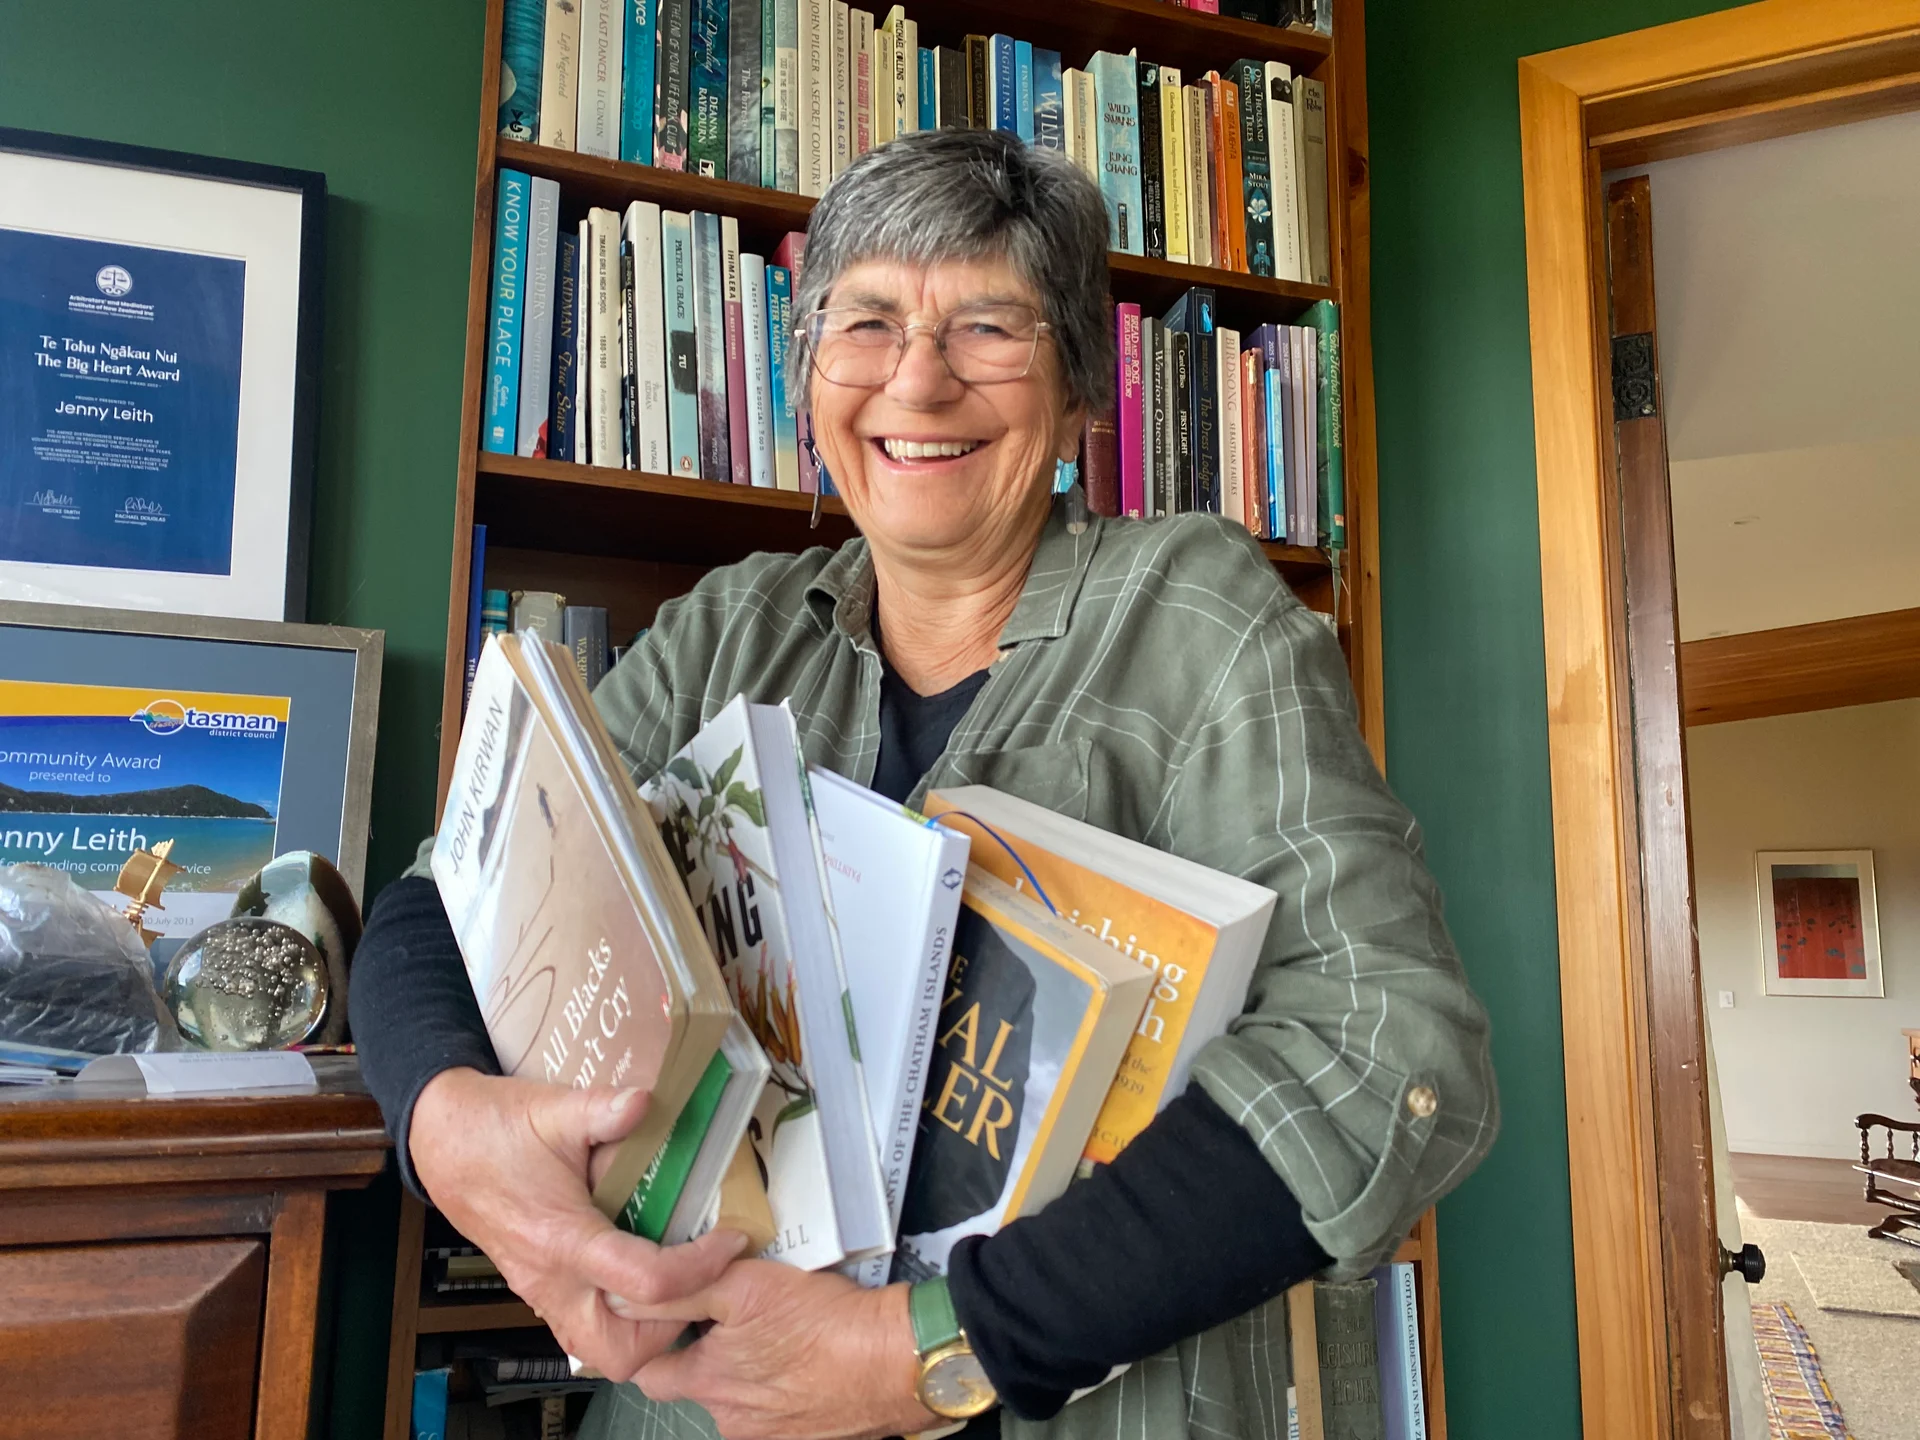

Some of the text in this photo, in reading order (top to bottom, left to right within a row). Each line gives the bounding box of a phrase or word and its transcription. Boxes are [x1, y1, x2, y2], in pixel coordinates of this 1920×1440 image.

[809, 0, 821, 31] JOHN
[836, 10, 845, 41] MARY
[556, 32, 571, 99] Left Neglected
[597, 13, 609, 82] LAST DANCER
[694, 20, 721, 73] Darjeeling
[811, 33, 821, 71] PILGER
[895, 20, 904, 80] MICHAEL COLLINS
[666, 3, 682, 147] THE END OF YOUR LIFE BOOK CLUB
[741, 68, 751, 87] The
[836, 46, 845, 91] BENSON
[1001, 42, 1012, 120] SIGHTLINES
[1021, 64, 1029, 112] FINDINGS
[697, 87, 708, 143] RAYBOURN
[811, 89, 821, 130] SECRET
[975, 72, 984, 120] GAWANDE
[1107, 103, 1131, 115] WILD
[1226, 89, 1235, 106] RAJ
[1243, 65, 1255, 142] CHESTNUT TREES
[1254, 68, 1265, 142] ONE THOUSAND
[708, 95, 719, 139] DEANNA
[1040, 91, 1059, 149] WILD
[1104, 114, 1136, 127] SWANS
[811, 132, 821, 188] COUNTRY
[837, 135, 846, 157] CRY
[1109, 151, 1132, 163] JUNG
[1105, 163, 1138, 175] CHANG
[1247, 181, 1268, 189] STOUT
[1249, 173, 1267, 181] MIRA
[495, 180, 522, 367] KNOW YOUR PLACE
[532, 195, 552, 321] JACINDA ARDERN
[727, 249, 736, 299] IHIMAERA
[675, 239, 686, 319] PATRICIA GRACE
[68, 301, 94, 310] Institute
[103, 304, 117, 312] New
[118, 306, 143, 316] Zealand
[108, 298, 120, 306] and
[599, 292, 607, 315] SCHOOL
[555, 241, 576, 434] Fiona KIDMAN True Stars
[771, 293, 783, 365] PETER MAHON
[1124, 333, 1132, 356] DAVIES
[1131, 314, 1139, 343] BREAD
[34, 352, 62, 369] The
[67, 356, 89, 375] Big
[93, 359, 133, 377] Heart
[136, 364, 180, 381] Award
[39, 335, 178, 364] Te Tohu Ngākau Nui
[599, 335, 607, 368] 1880-1980
[678, 354, 687, 370] TU
[750, 281, 766, 452] Janet Frame In the Memorial Room
[1131, 360, 1140, 385] ROSES
[1155, 350, 1164, 404] Warrior
[1225, 336, 1237, 411] BIRDSONG
[1329, 329, 1343, 448] The Herbal Yearbook
[55, 401, 153, 423] Jenny Leith
[1154, 408, 1165, 454] Queen
[650, 440, 658, 470] VINTAGE
[711, 437, 719, 464] VINTAGE
[1199, 396, 1212, 492] The Dress Lodger
[1229, 422, 1237, 464] SEBASTIAN
[468, 658, 476, 677] THE
[186, 708, 278, 732] tasman
[209, 728, 276, 740] district council
[0, 751, 161, 771] ommunity Award
[29, 770, 111, 784] presented to
[451, 697, 505, 874] JOHN KIRWAN
[0, 827, 147, 857] nny Leith
[155, 916, 174, 927] July
[174, 917, 195, 927] 2013
[540, 936, 613, 1082] All Blacks
[598, 975, 632, 1041] Cry
[892, 926, 950, 1163] OF THE CHATHAM ISLANDS
[1404, 1272, 1422, 1427] COTTAGE GARDENING IN NEW
